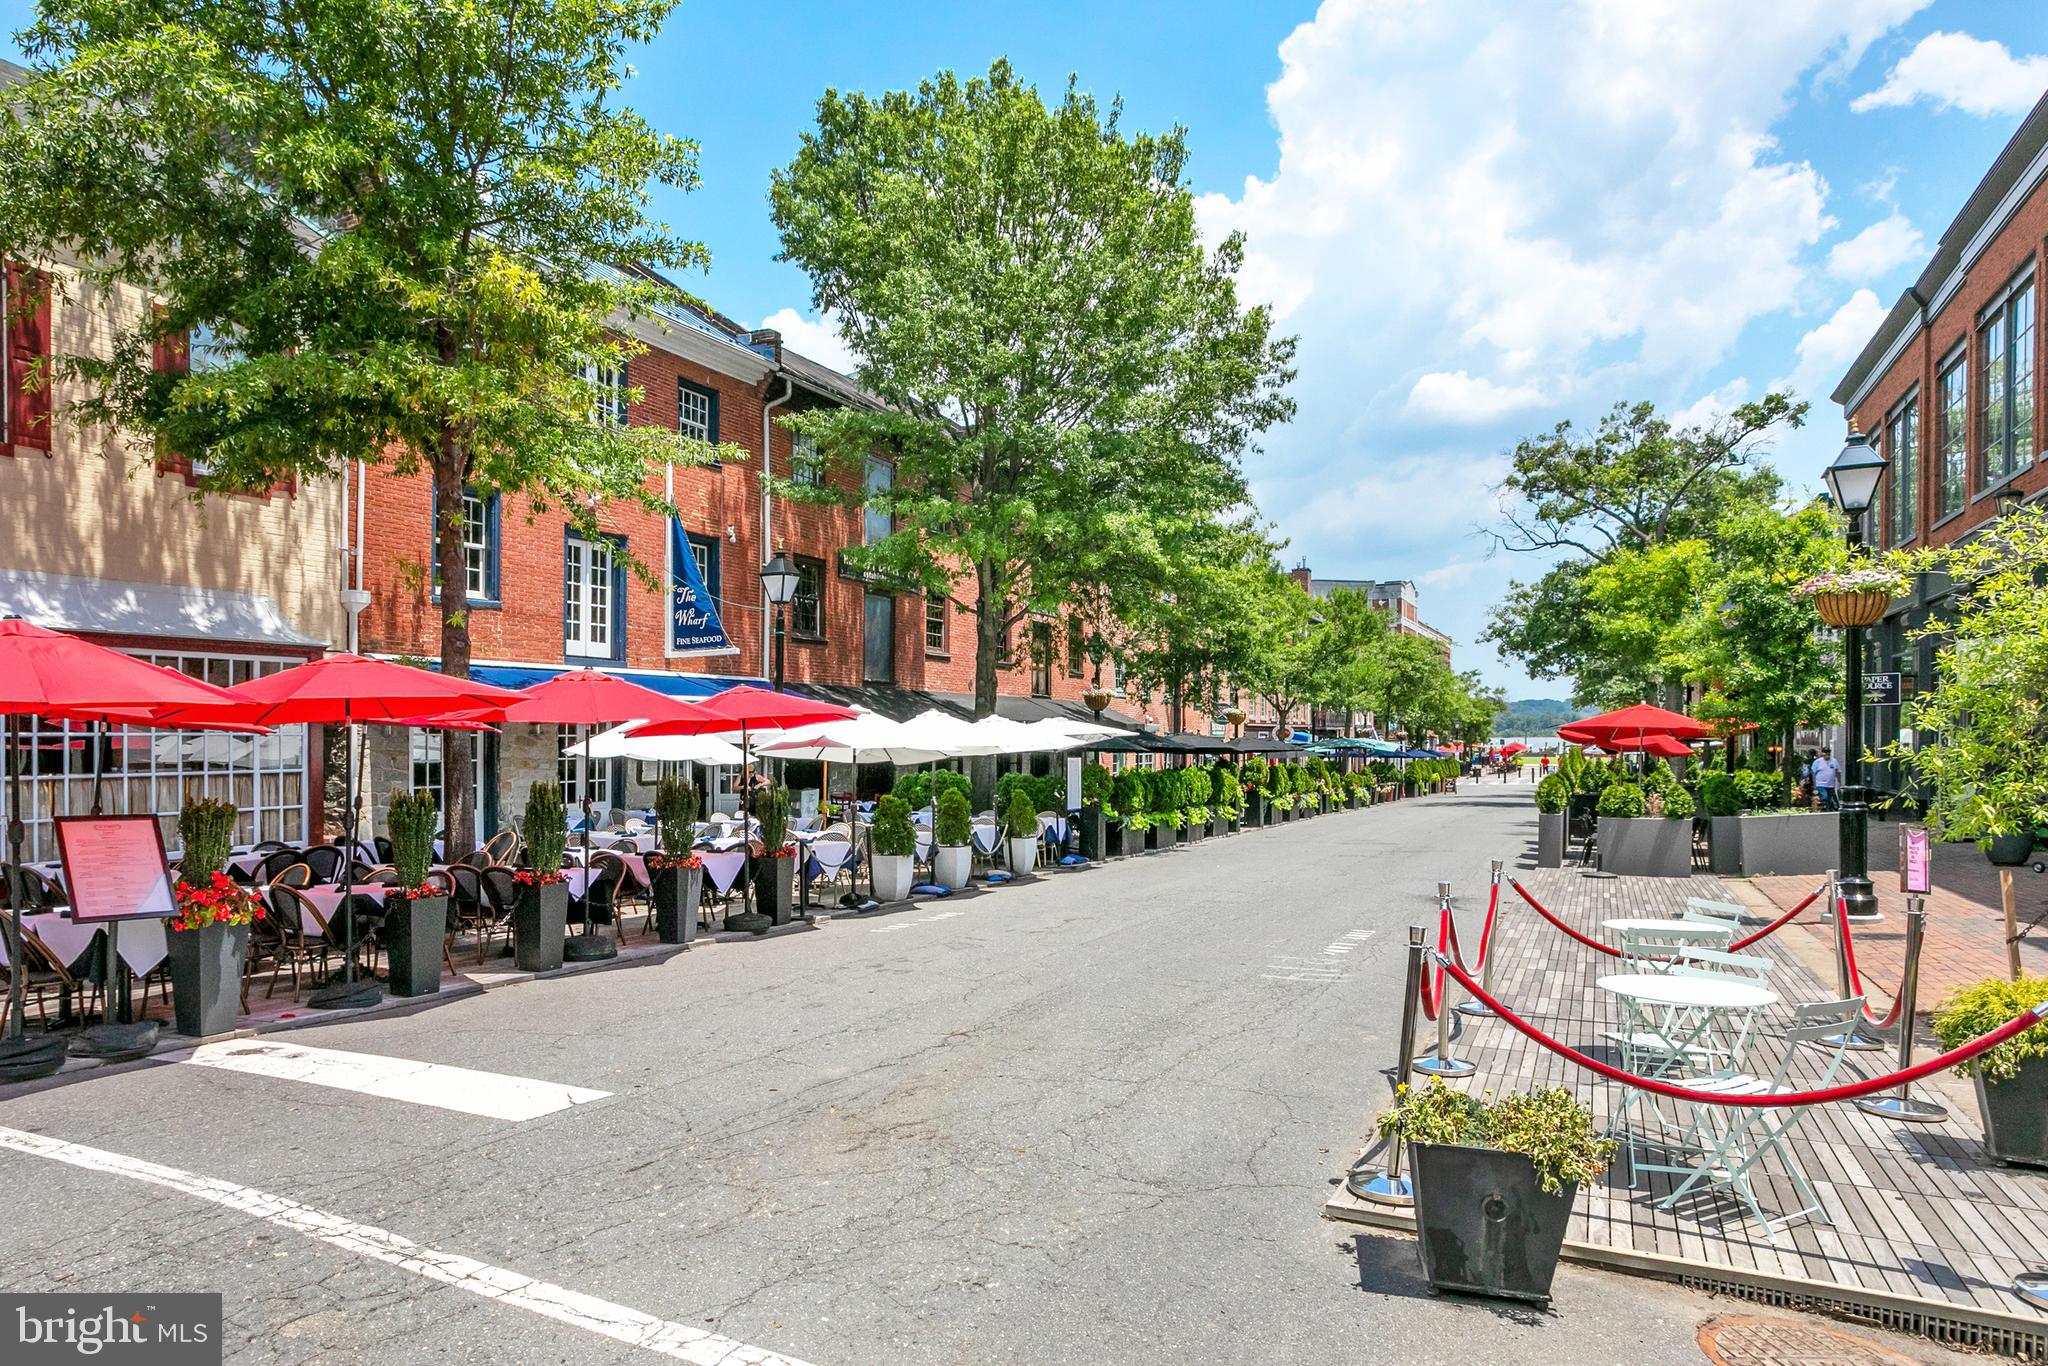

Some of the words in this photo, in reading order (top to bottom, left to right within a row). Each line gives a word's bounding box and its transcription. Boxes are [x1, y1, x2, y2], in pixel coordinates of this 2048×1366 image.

[676, 586, 697, 605] The
[674, 607, 711, 630] Wharf
[676, 637, 691, 646] FINE
[691, 634, 722, 645] SEAFOOD
